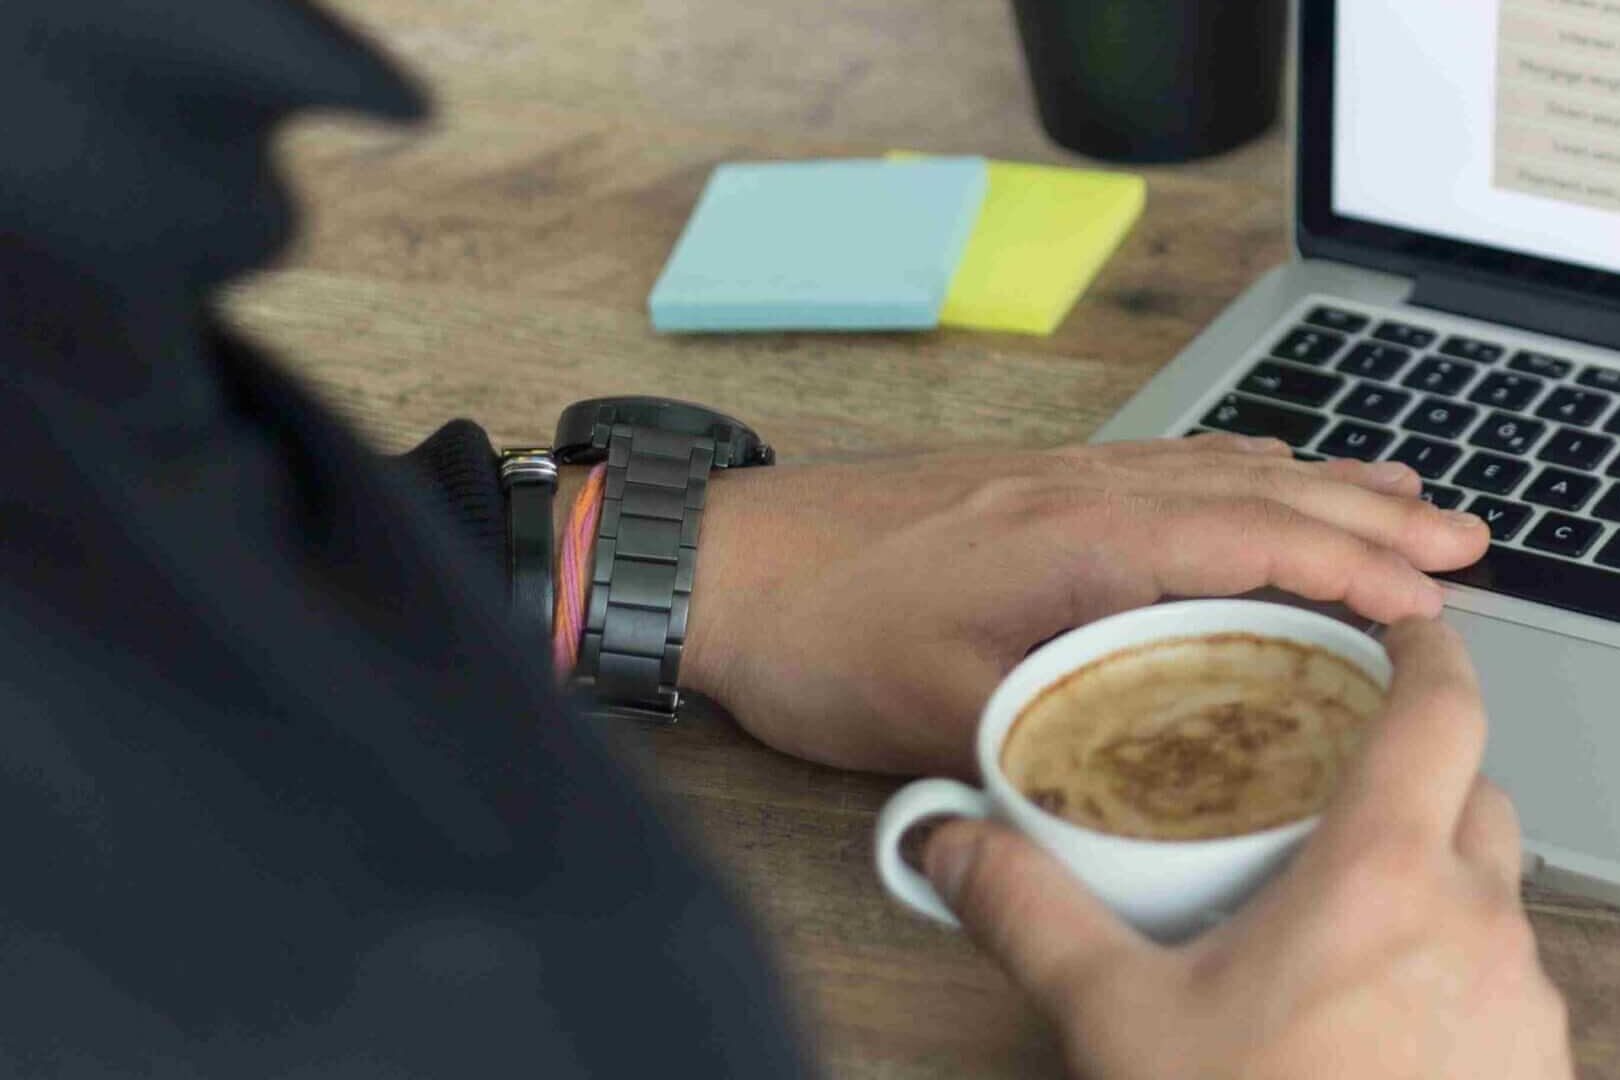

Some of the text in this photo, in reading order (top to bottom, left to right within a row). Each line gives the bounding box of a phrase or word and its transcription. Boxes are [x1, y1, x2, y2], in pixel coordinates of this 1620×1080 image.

[1347, 432, 1367, 446] U
[1484, 464, 1500, 477] E
[1550, 481, 1568, 494] A
[1487, 508, 1504, 521] V
[1554, 525, 1573, 539] C
